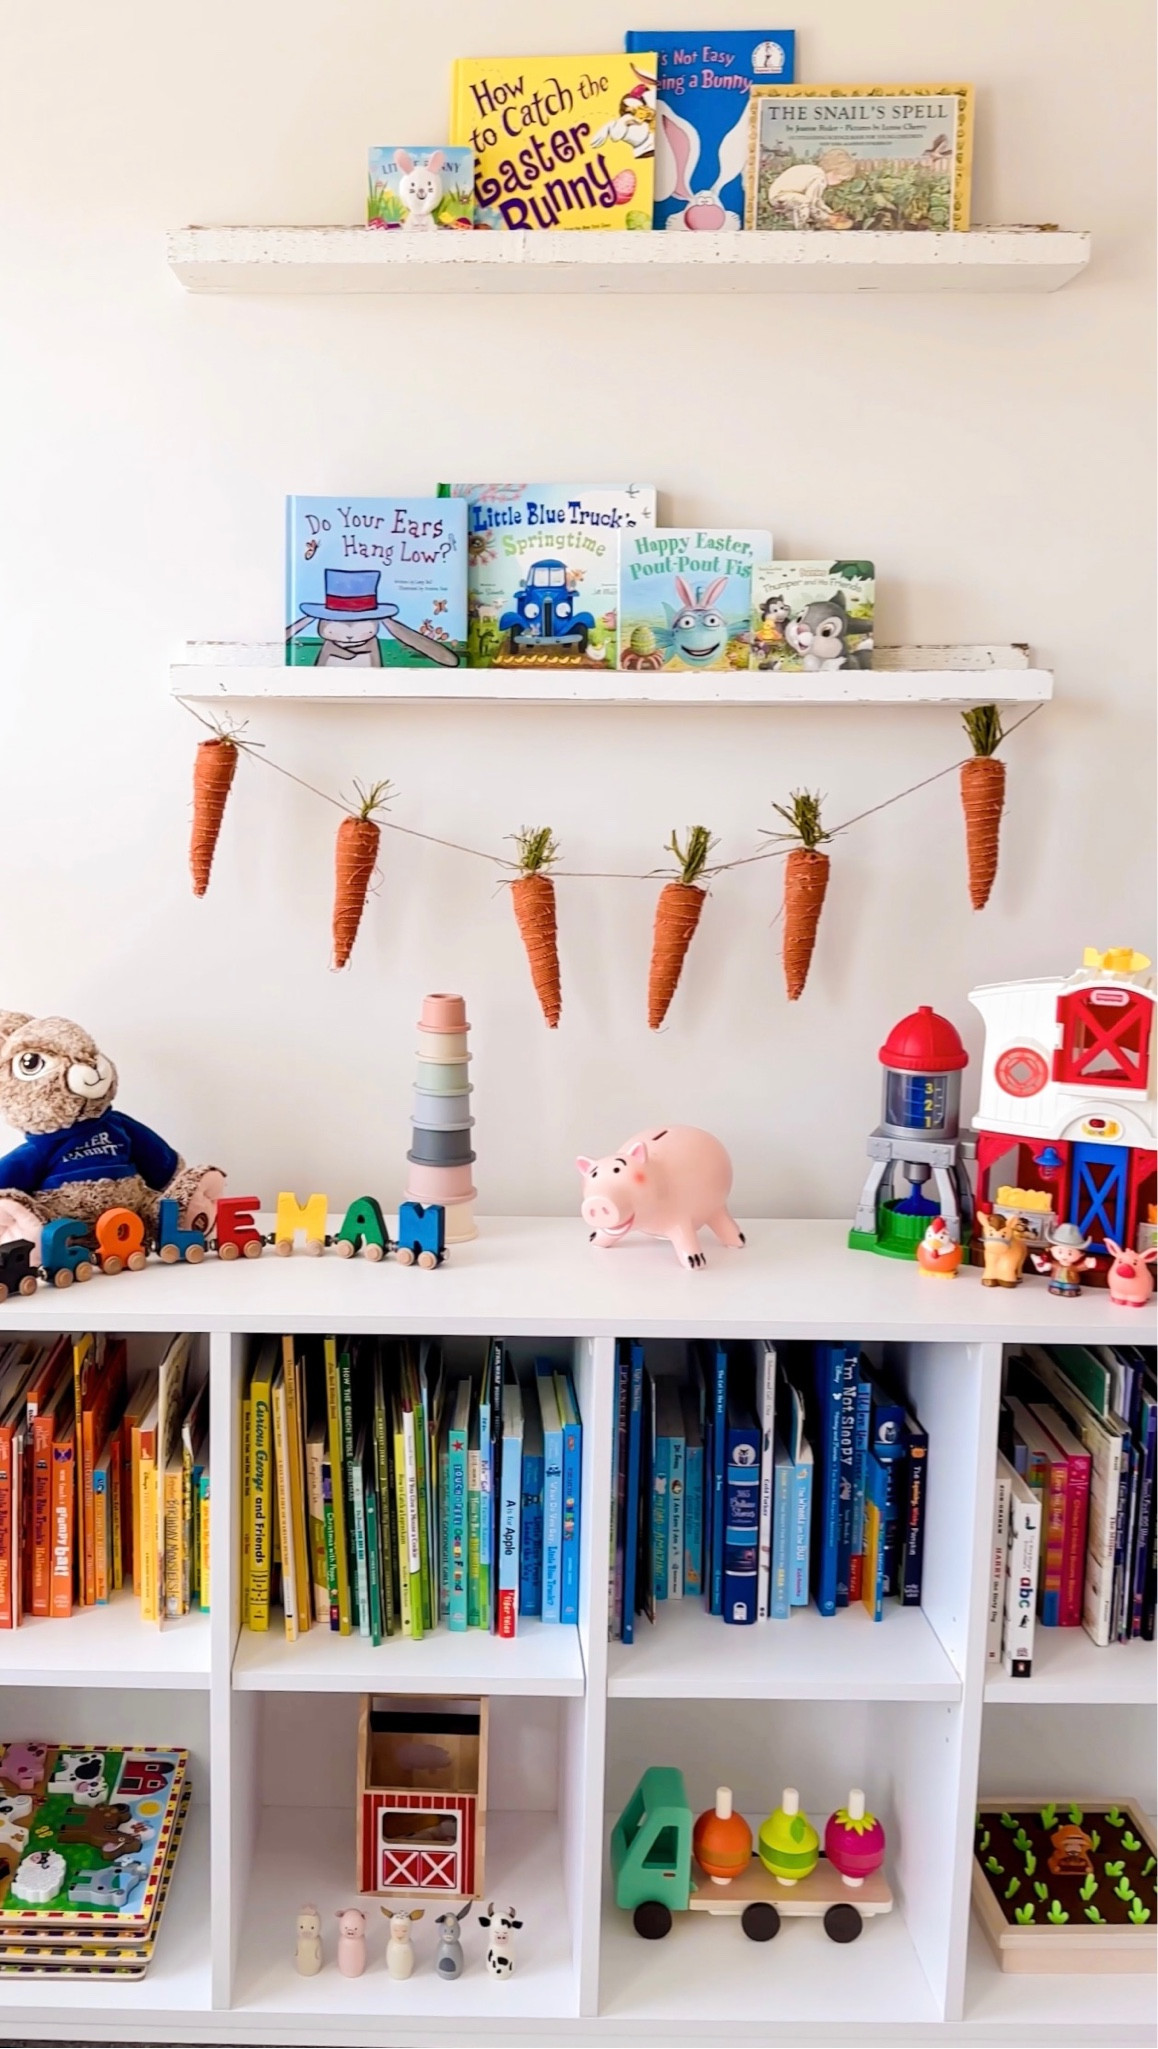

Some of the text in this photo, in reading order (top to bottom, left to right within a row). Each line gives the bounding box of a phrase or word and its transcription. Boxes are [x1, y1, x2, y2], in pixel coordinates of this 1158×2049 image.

[673, 46, 736, 67] Not Easy
[688, 69, 753, 94] a Bunny
[469, 75, 524, 118] How
[469, 73, 609, 153] to Catch the
[768, 104, 948, 120] THE SNAIL'S SPELL
[474, 122, 590, 210] Easter
[500, 153, 618, 231] Bunny
[305, 507, 444, 539] Do Your Ears
[473, 501, 637, 532] Little Blue Truck's
[342, 534, 451, 566] Hang Low?
[502, 531, 606, 557] Springtime
[635, 532, 754, 556] Happy Easter,
[629, 556, 751, 580] Pout-Pout Fis
[763, 580, 802, 592] Thumper
[924, 1082, 933, 1095] 3
[924, 1099, 933, 1111] 2
[924, 1116, 931, 1128] 1
[717, 1370, 725, 1379] The
[717, 1380, 725, 1389] Cat
[632, 1368, 641, 1412] Ugly Duckling
[342, 1367, 354, 1457] HOW THE GRINCH STOLE
[840, 1357, 858, 1465] I'm Not Sleepy
[253, 1400, 269, 1564] Curious George and Friends
[453, 1464, 464, 1495] TOUCH
[481, 1460, 489, 1493] Pete Cat
[1054, 1475, 1064, 1491] Love
[506, 1500, 516, 1508] A
[549, 1481, 558, 1501] What
[549, 1503, 557, 1512] Do
[673, 1503, 680, 1513] Am
[762, 1495, 770, 1517] Turkey
[798, 1498, 807, 1524] Wheels
[909, 1466, 921, 1555] The Pumpkin
[326, 1513, 335, 1546] Christmas
[399, 1514, 407, 1544] Leprechaun
[549, 1513, 557, 1527] You
[798, 1525, 804, 1534] on
[1053, 1509, 1063, 1530] Daddy
[54, 1507, 70, 1577] grumpy bat!
[166, 1500, 180, 1594] BIRTHDAY MONSTERS!
[454, 1528, 464, 1559] Ocean
[503, 1528, 516, 1555] Apple
[673, 1534, 680, 1544] Am
[797, 1535, 805, 1545] the
[1068, 1499, 1081, 1603] Chicka Chicka Boom Boom
[1107, 1532, 1116, 1557] Mitten
[36, 1547, 46, 1587] Halloween
[329, 1548, 337, 1562] with
[547, 1546, 558, 1564] Little
[994, 1547, 1002, 1579] HARRY
[521, 1563, 533, 1582] Way
[547, 1565, 557, 1579] Blue
[547, 1580, 556, 1606] Truck?
[1019, 1577, 1034, 1609] abc
[503, 1594, 514, 1634] tiger tales
